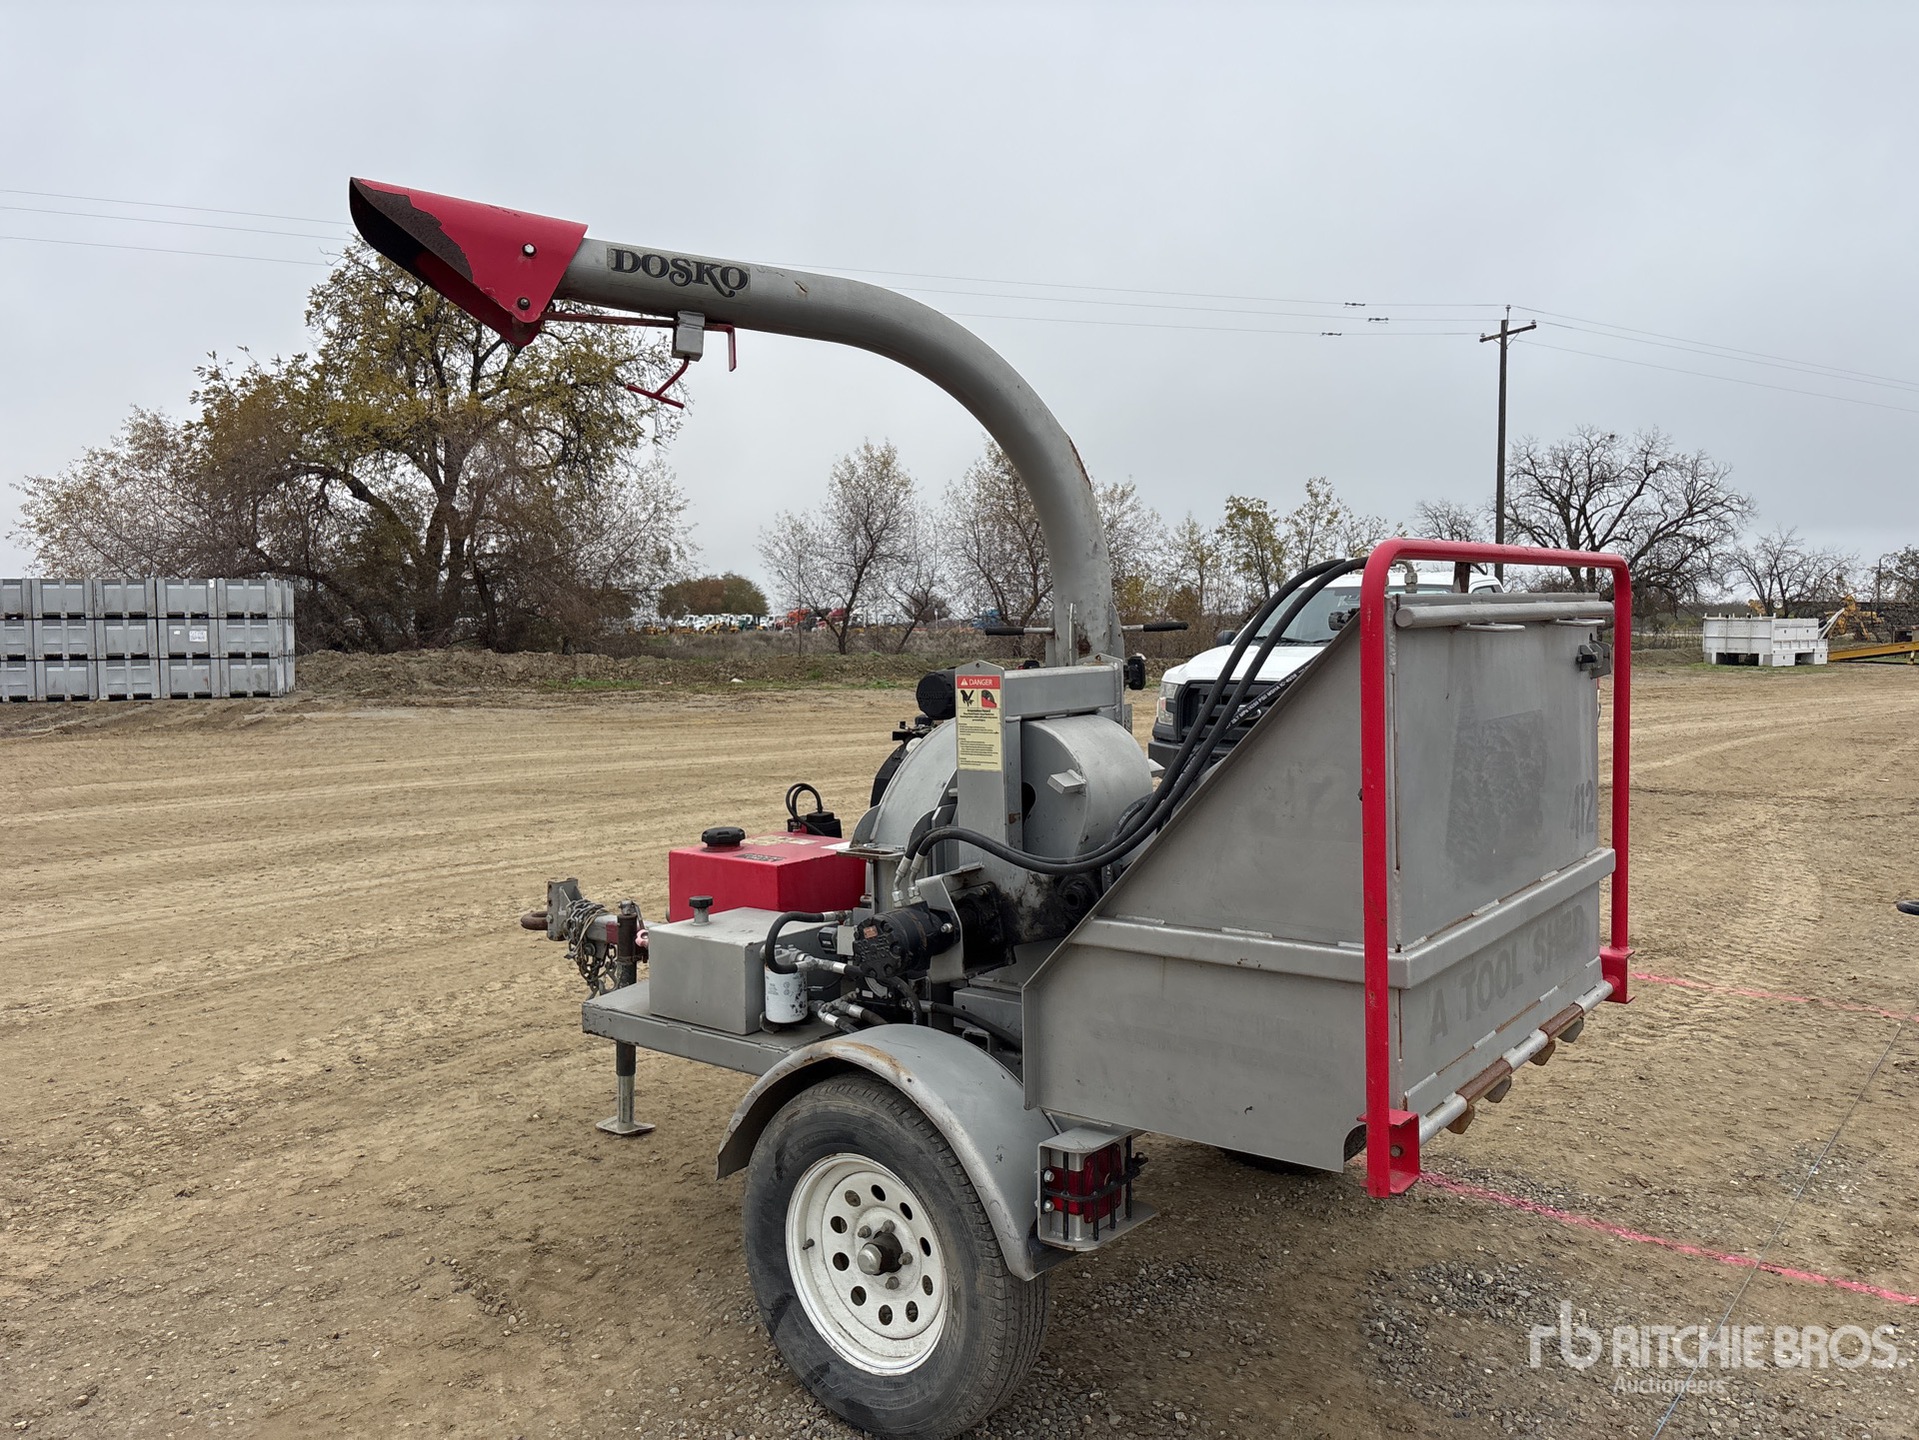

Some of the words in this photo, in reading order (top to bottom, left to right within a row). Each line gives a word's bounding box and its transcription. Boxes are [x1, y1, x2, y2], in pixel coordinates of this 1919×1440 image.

[611, 248, 748, 298] DOSKO
[968, 678, 993, 686] DANGER
[1430, 988, 1449, 1046] A
[1459, 942, 1524, 1022] TOOL
